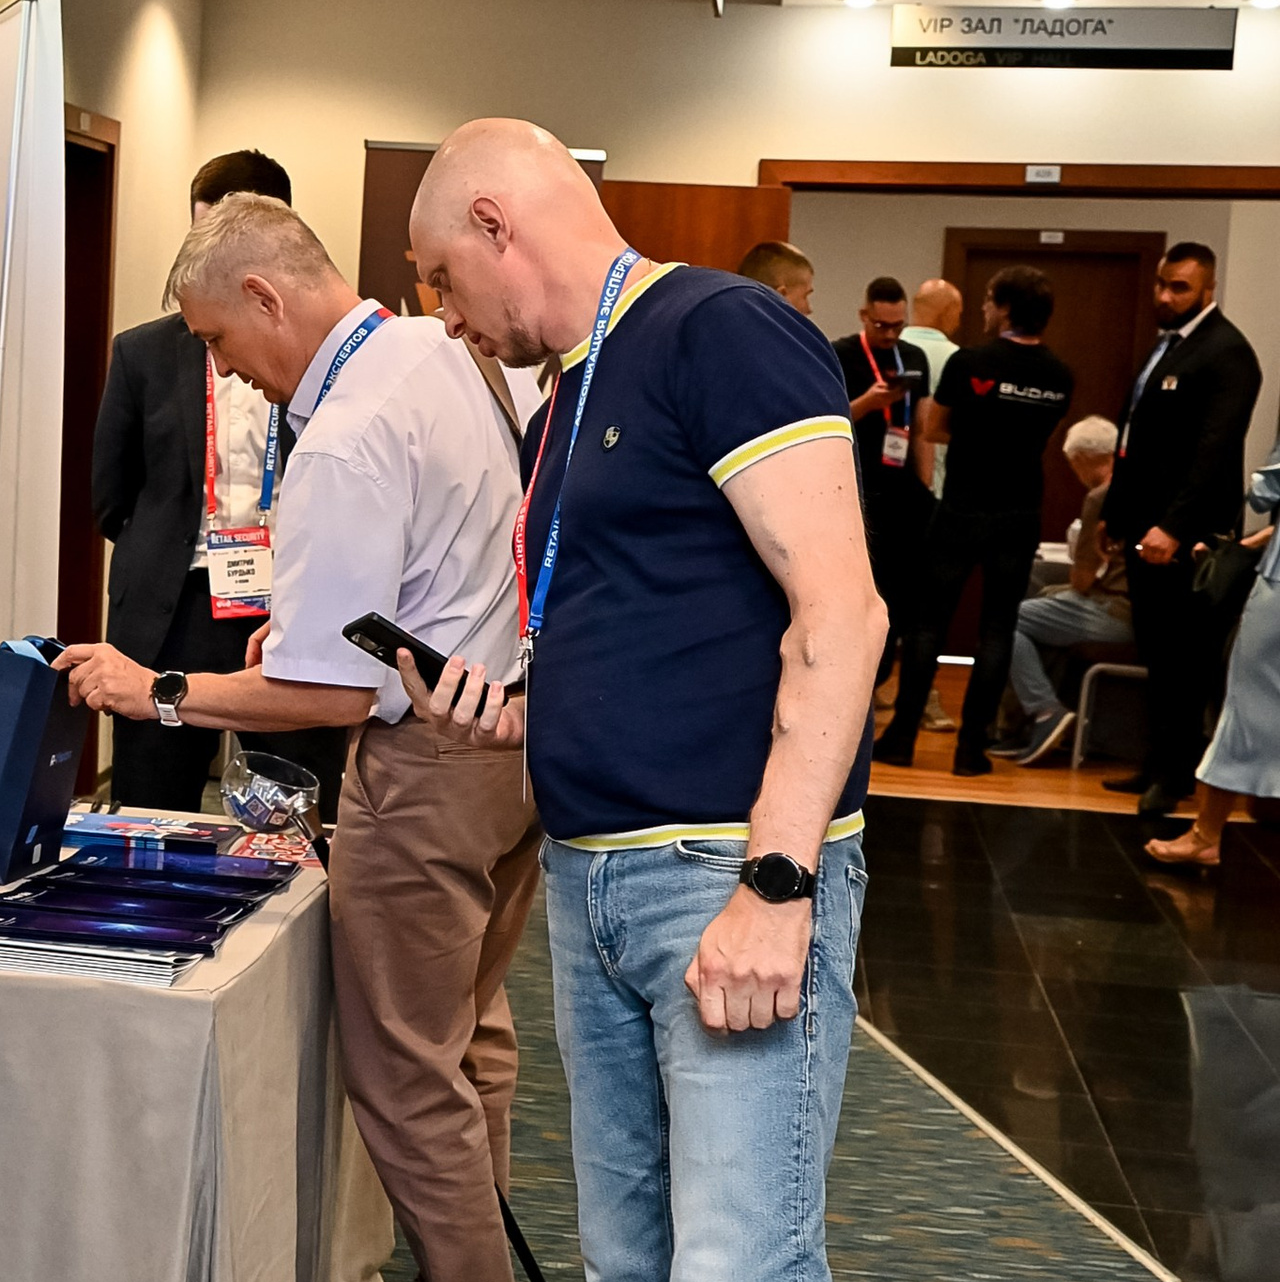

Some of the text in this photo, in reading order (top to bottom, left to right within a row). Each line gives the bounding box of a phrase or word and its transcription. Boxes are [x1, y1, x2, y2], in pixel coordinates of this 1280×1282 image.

[915, 51, 986, 65] LADOGA
[919, 18, 1114, 37] VIP ЗАЛ "ЛАДОГА"
[326, 327, 368, 387] ЭКСПЕРТОВ
[575, 251, 638, 427] АССОЦИАЦИЯ ЭКСПЕРТОВ
[206, 403, 216, 479] RETAIL SECURITY
[266, 403, 280, 471] RETAIL SECURI
[515, 506, 527, 576] SECURITY
[544, 518, 560, 568] RETAIL
